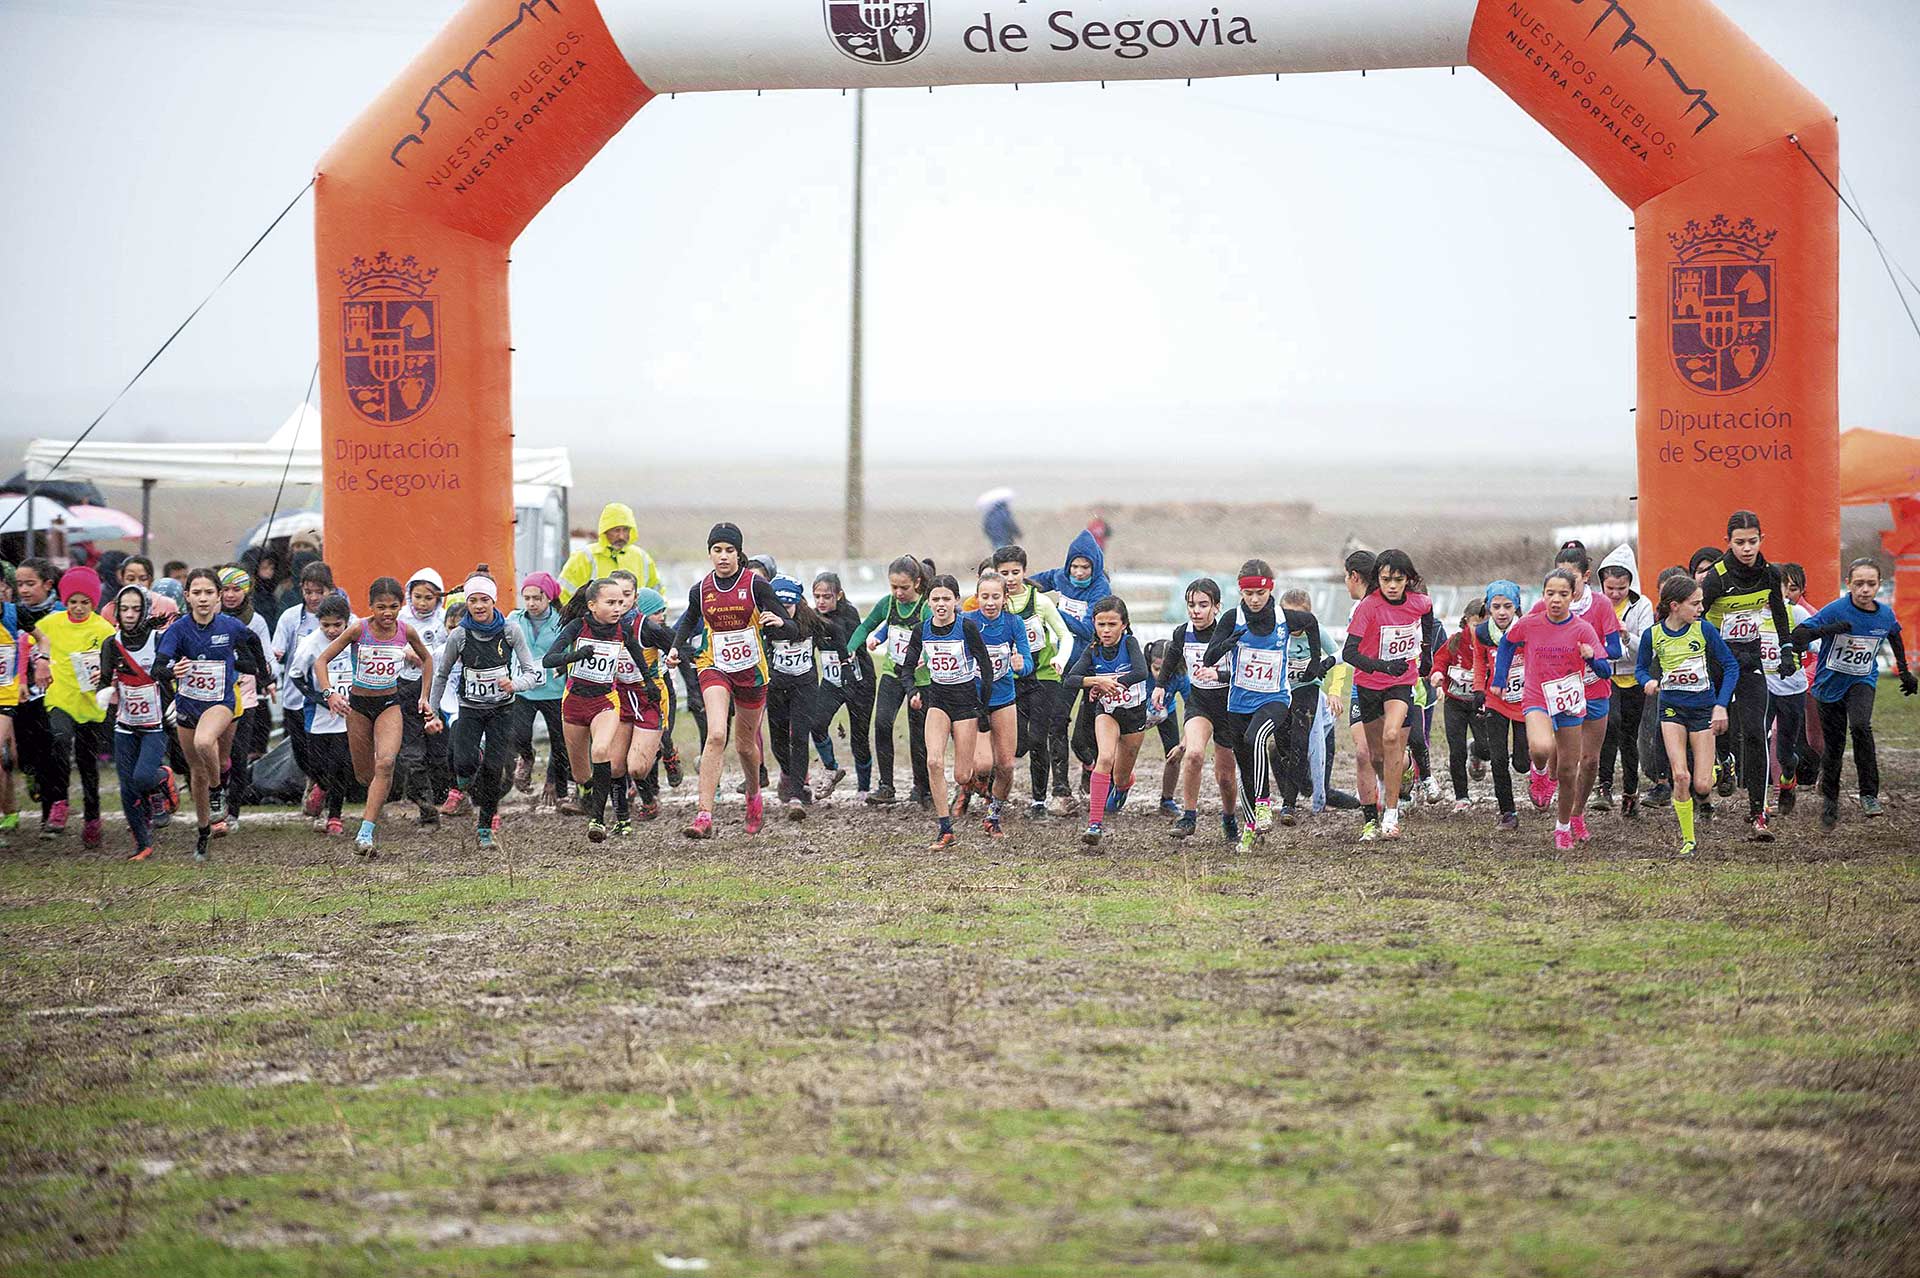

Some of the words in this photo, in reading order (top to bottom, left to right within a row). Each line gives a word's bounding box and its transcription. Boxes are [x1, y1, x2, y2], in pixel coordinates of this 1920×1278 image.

[963, 13, 1028, 53] de
[1050, 7, 1257, 59] Segovia
[1508, 2, 1597, 85] NUESTROS
[1600, 85, 1677, 159] PUEBLOS.
[1506, 30, 1568, 90] NUESTRA
[1572, 89, 1649, 162] FORTALEZA
[426, 106, 509, 190] NUESTROS
[510, 30, 584, 103] PUEBLOS.
[455, 136, 515, 195] NUESTRA
[515, 59, 587, 132] FORTALEZA
[1660, 405, 1792, 436] Diputación
[336, 437, 460, 465] Diputación
[1659, 440, 1684, 463] de
[1694, 439, 1793, 468] Segovia
[336, 470, 359, 491] de
[366, 469, 461, 497] Segovia
[1729, 622, 1757, 638] 404
[721, 644, 752, 662] 986
[1389, 637, 1415, 654] 805
[579, 655, 615, 672] 1901
[778, 651, 809, 666] 1576
[932, 658, 959, 671] 552
[1836, 647, 1871, 665] 1280
[365, 661, 396, 676] 298
[1244, 664, 1273, 681] 514
[187, 675, 217, 691] 283
[1668, 673, 1699, 684] 269
[1556, 690, 1580, 711] 812
